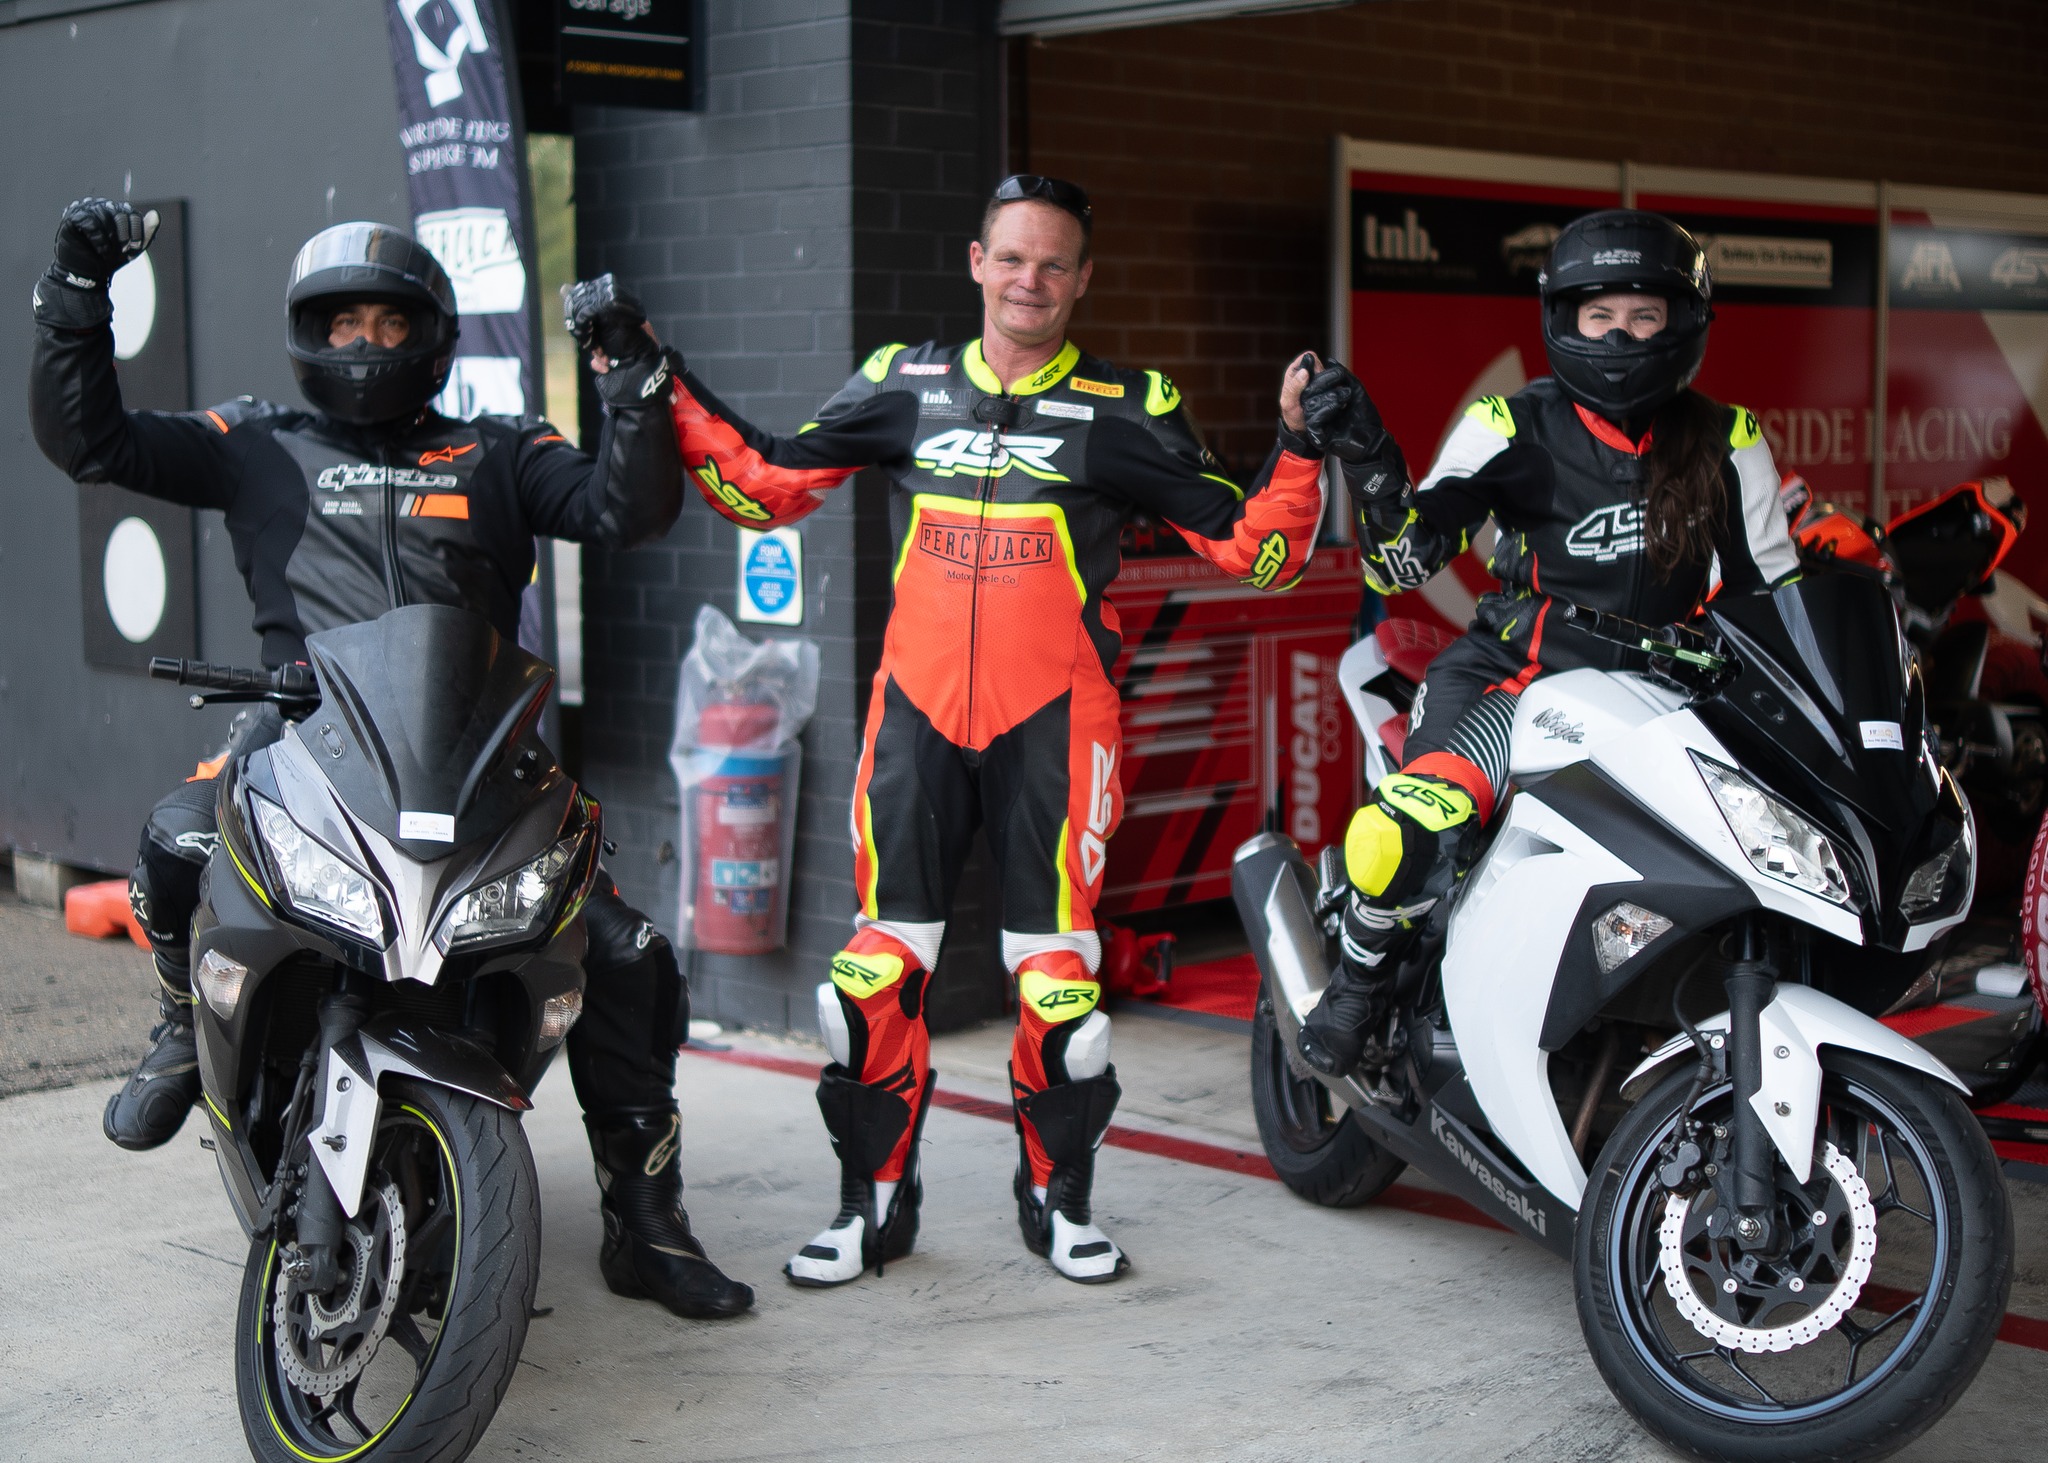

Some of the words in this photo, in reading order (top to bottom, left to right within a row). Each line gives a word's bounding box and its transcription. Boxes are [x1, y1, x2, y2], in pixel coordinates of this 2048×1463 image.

[1031, 363, 1063, 388] 4SR
[915, 428, 1068, 479] 4SR
[694, 455, 774, 520] 4SR
[1240, 531, 1290, 591] 4SR
[1321, 655, 1342, 763] CORSE
[1290, 649, 1321, 843] DUCATI
[1391, 784, 1459, 821] 4SR
[832, 959, 883, 987] 4SR
[1037, 988, 1095, 1010] 4SR
[1429, 1106, 1546, 1237] Kawasaki
